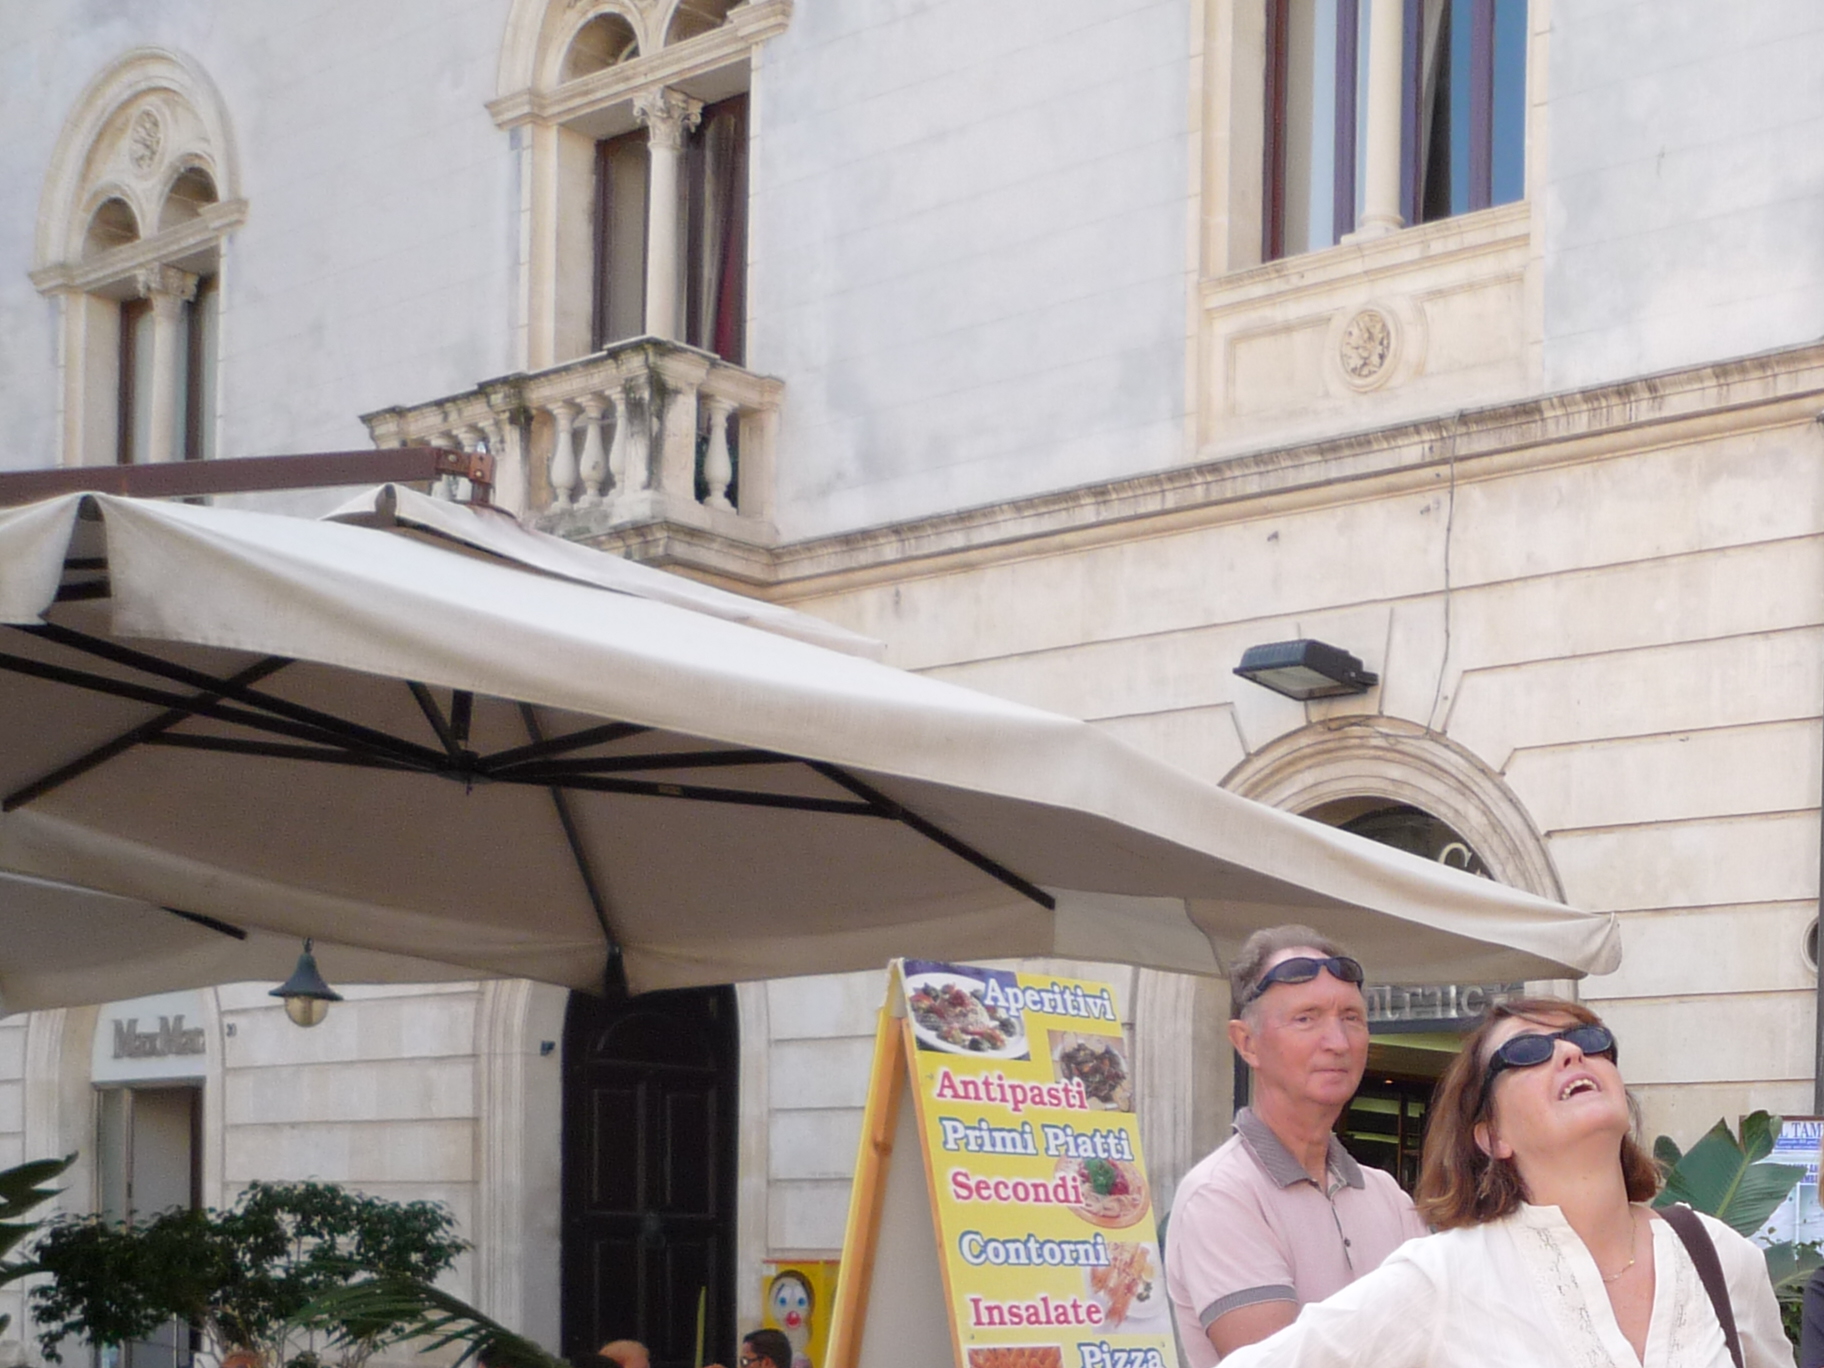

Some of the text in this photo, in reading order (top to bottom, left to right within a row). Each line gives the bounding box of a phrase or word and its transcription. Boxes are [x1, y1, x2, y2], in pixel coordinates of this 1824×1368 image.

[984, 978, 1116, 1021] Aperitivi
[937, 1070, 1088, 1112] Antipasti
[939, 1117, 1134, 1161] Primi Piatti
[951, 1171, 1084, 1205] Secondi
[958, 1231, 1110, 1267] Contorni
[970, 1296, 1103, 1327] Insalate
